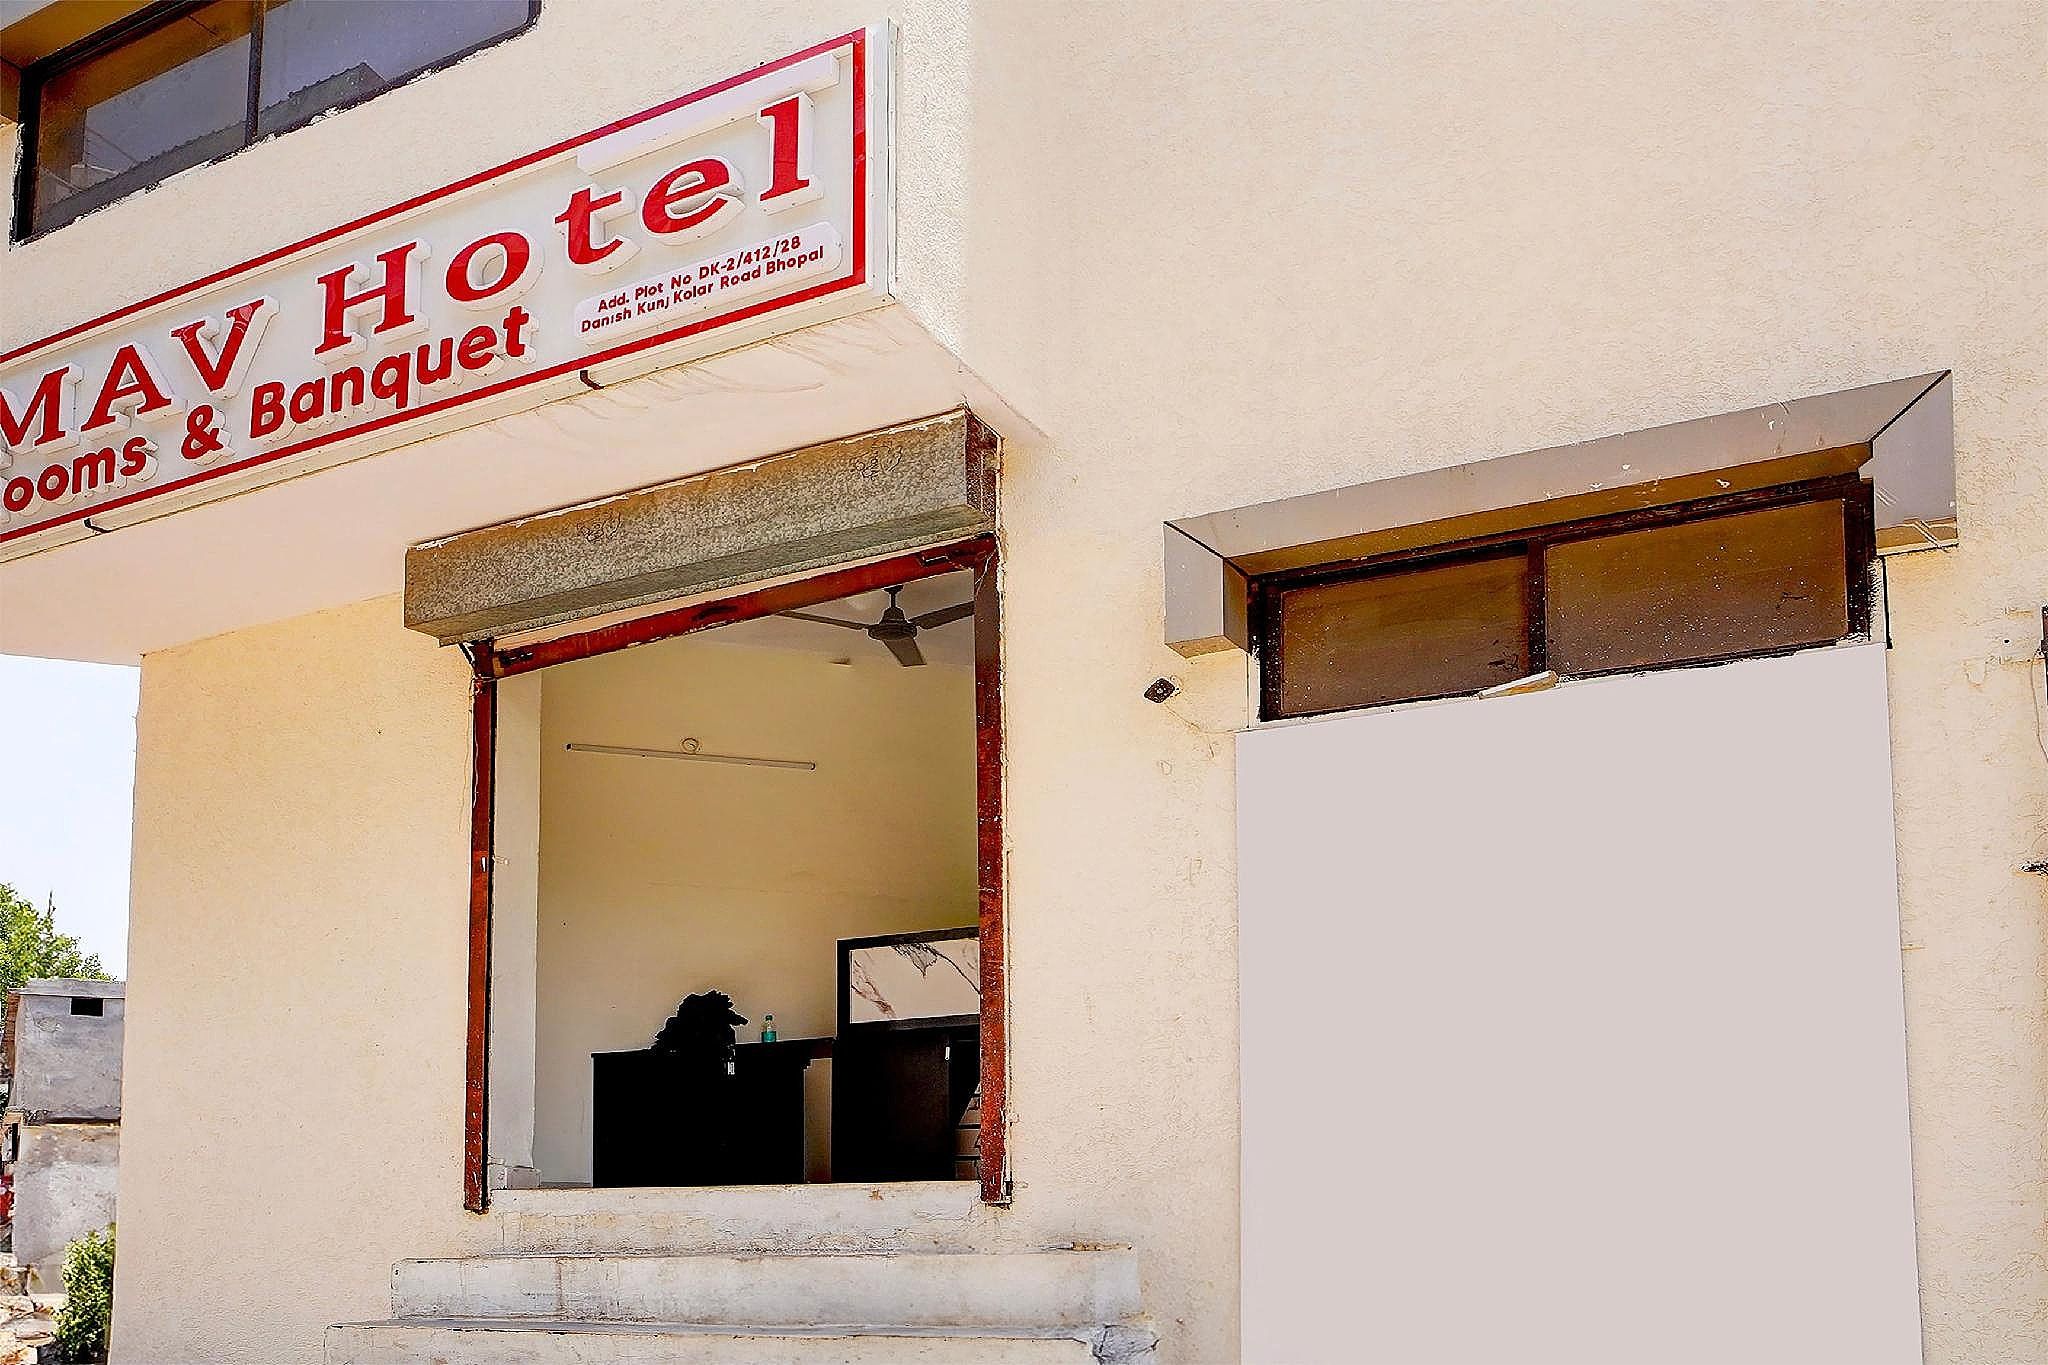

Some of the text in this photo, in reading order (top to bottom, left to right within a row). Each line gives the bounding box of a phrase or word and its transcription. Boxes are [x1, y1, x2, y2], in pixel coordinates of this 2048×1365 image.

[315, 97, 810, 355] Hotel
[598, 235, 801, 313] Add. Plot No DK-2/412/28
[581, 245, 824, 333] Danish Kunj Kolar Road Bhopal
[181, 404, 224, 460] &
[249, 306, 530, 439] Banquet
